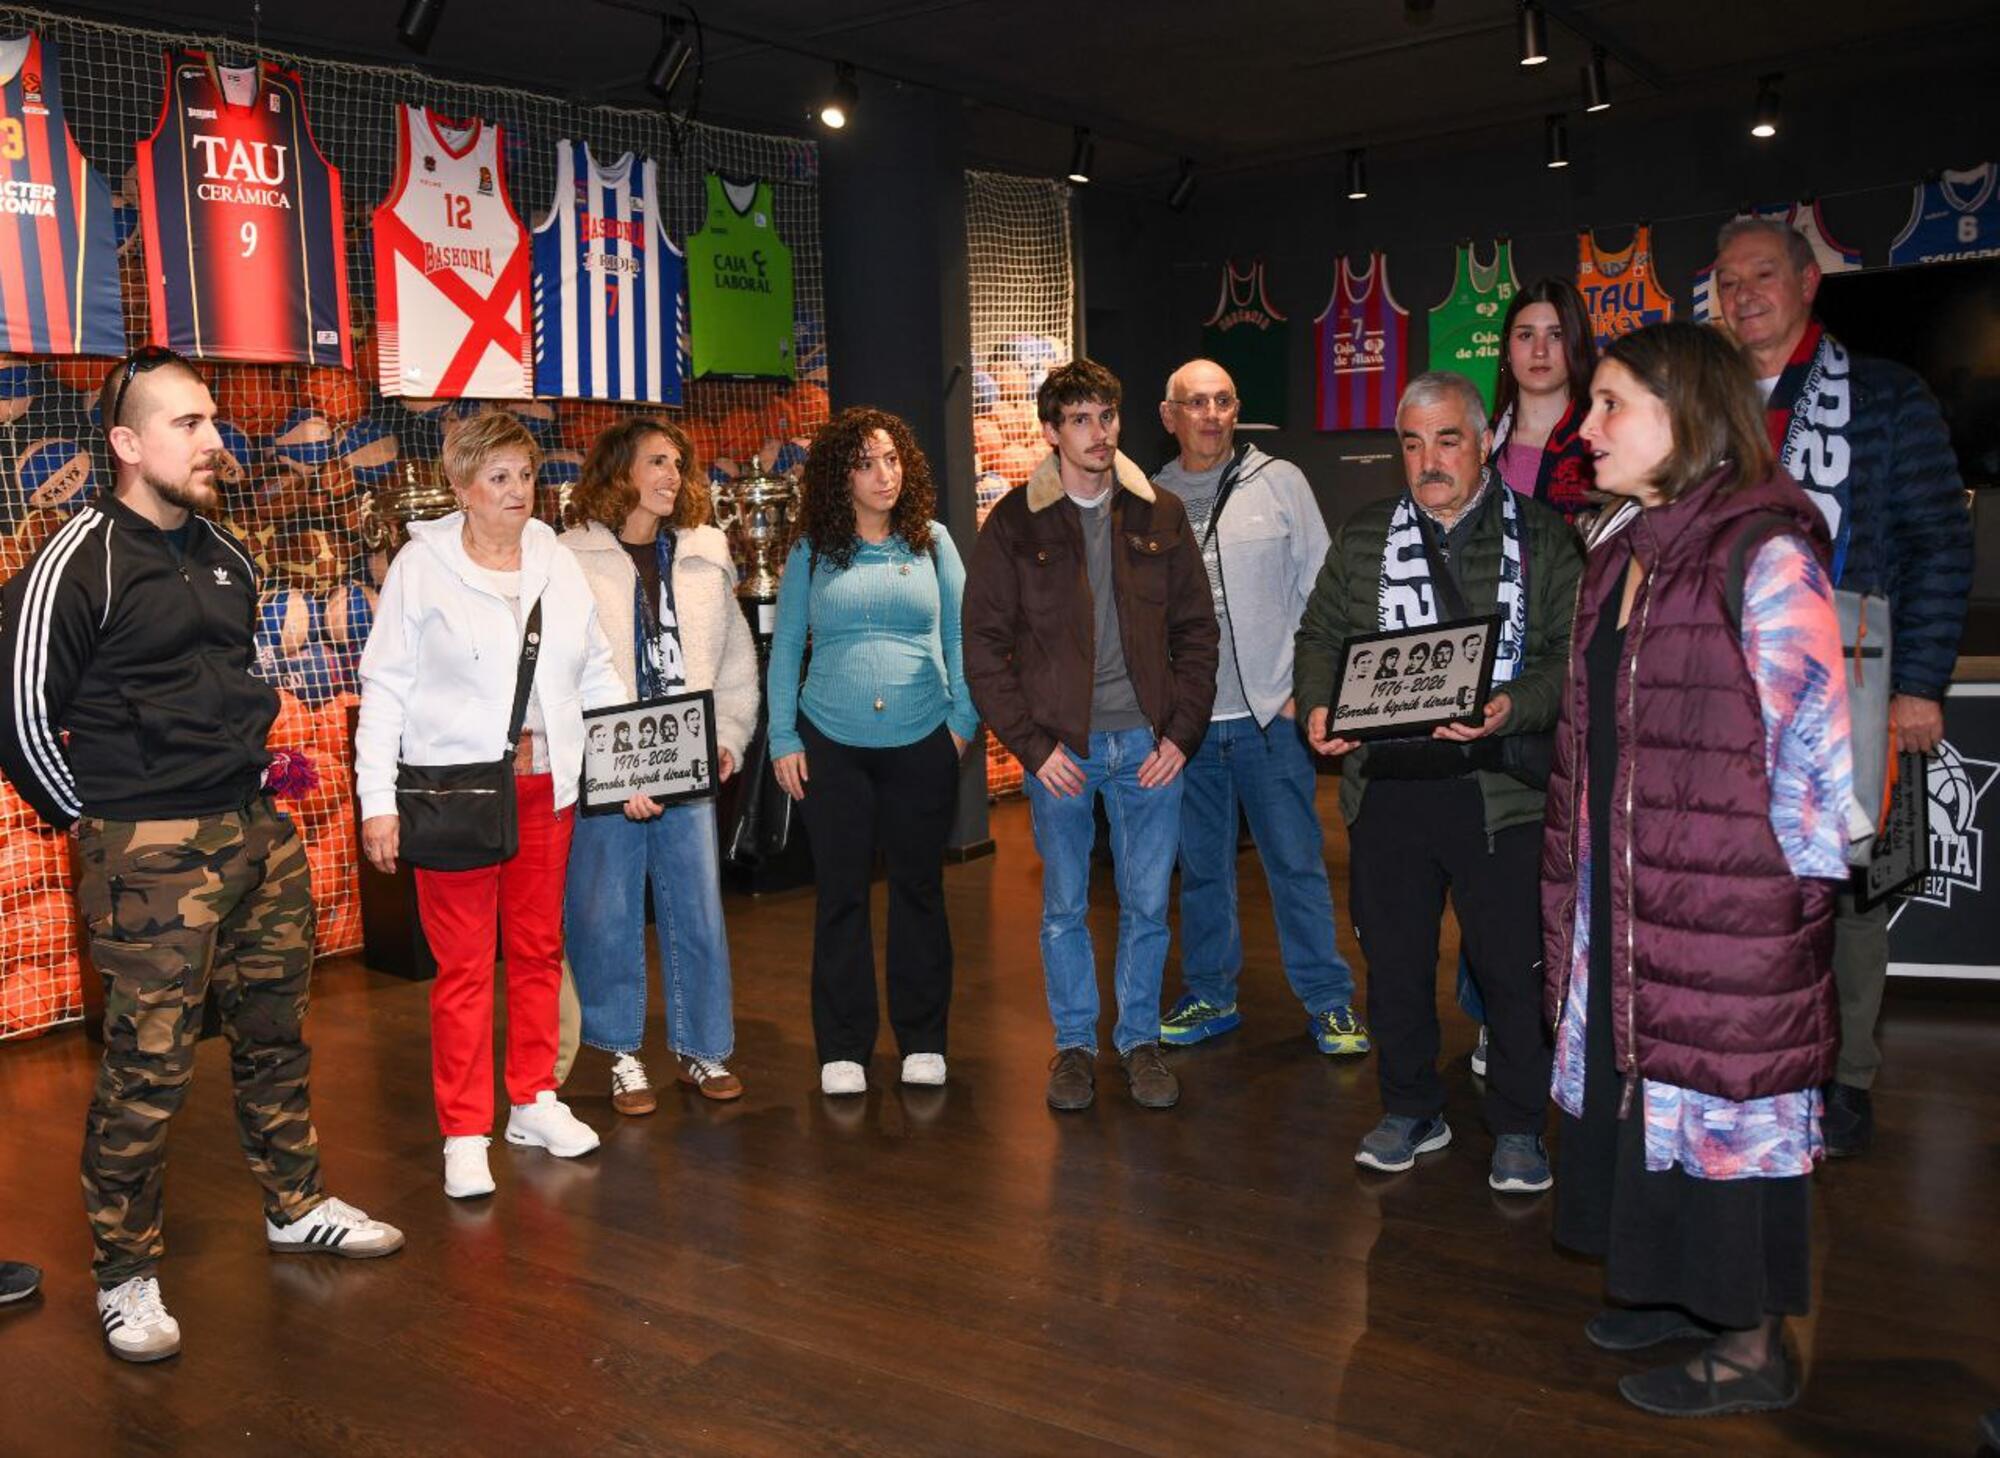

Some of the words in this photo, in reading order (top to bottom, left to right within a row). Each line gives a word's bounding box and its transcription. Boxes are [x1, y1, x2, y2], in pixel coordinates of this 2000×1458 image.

[192, 134, 287, 185] TAU
[0, 181, 56, 201] CTER
[196, 183, 291, 209] CERÁMICA
[0, 198, 56, 218] ONIA
[444, 193, 472, 230] 12
[240, 222, 257, 257] 9
[424, 242, 494, 278] BASKONIA
[715, 274, 772, 294] LABORAL
[1497, 282, 1511, 300] 15
[605, 283, 618, 318] 7
[1584, 281, 1644, 314] TAU
[1352, 318, 1364, 340] 7
[1455, 347, 1473, 359] de
[1370, 674, 1448, 698] 1976-2026
[613, 747, 678, 771] 1976-2026
